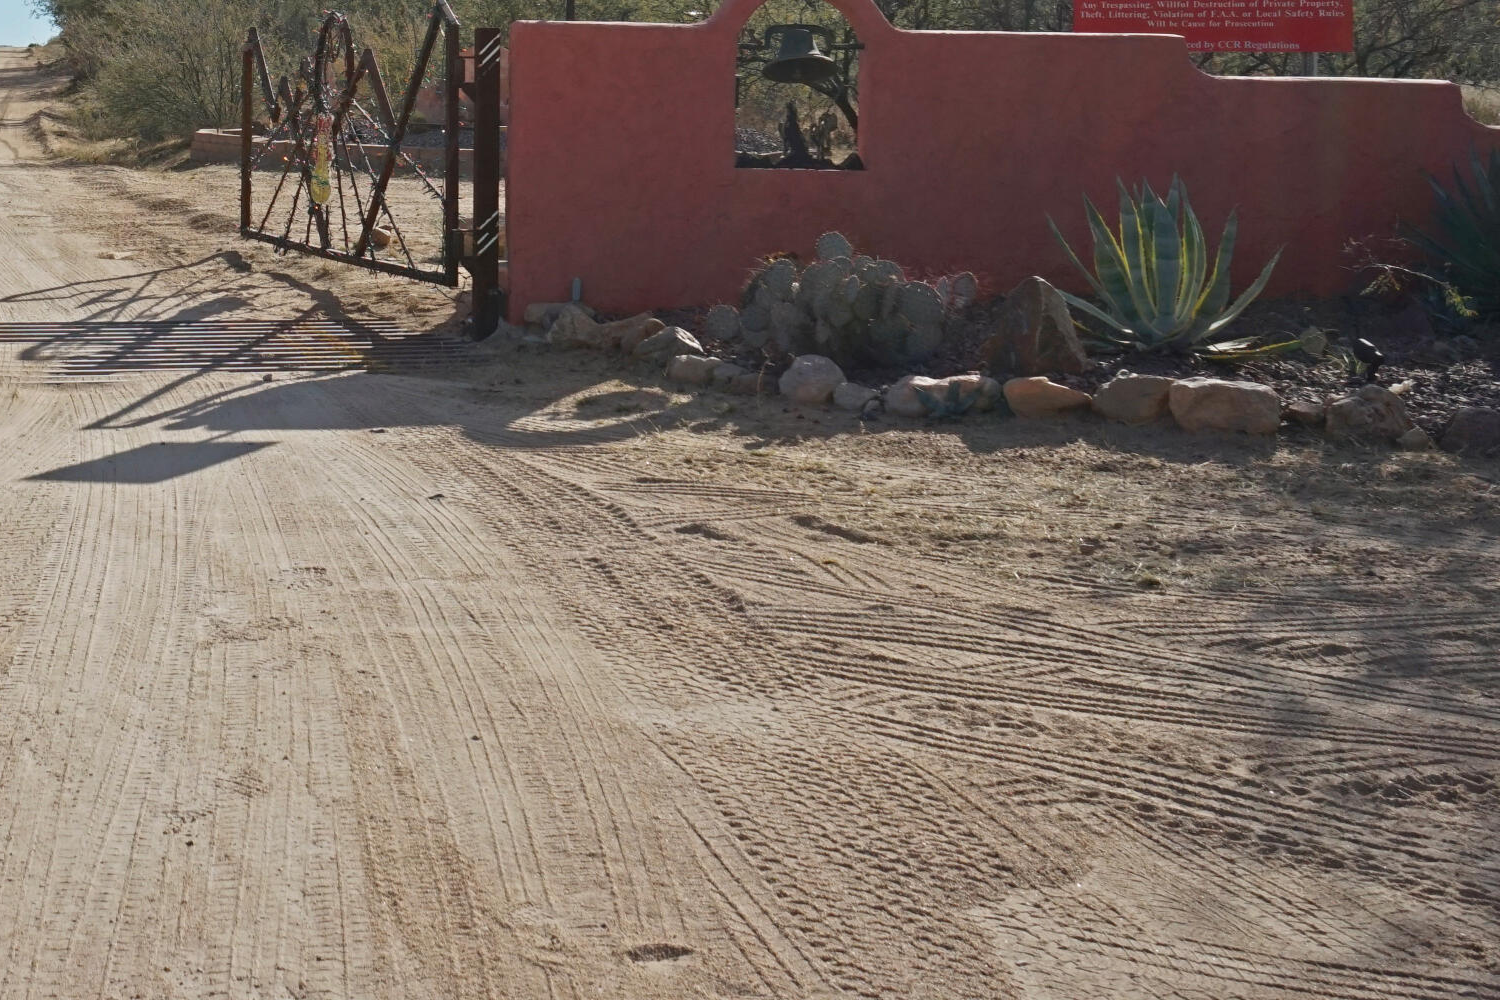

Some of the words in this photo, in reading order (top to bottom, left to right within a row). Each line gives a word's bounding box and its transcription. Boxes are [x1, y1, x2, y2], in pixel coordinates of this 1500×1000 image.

[1101, 2, 1152, 10] Trespassing,
[1194, 0, 1245, 8] Destruction
[1300, 0, 1343, 8] Property,
[1109, 11, 1150, 19] Littering,
[1285, 10, 1314, 18] Safety
[1204, 42, 1214, 50] by
[1244, 41, 1300, 50] Regulations
